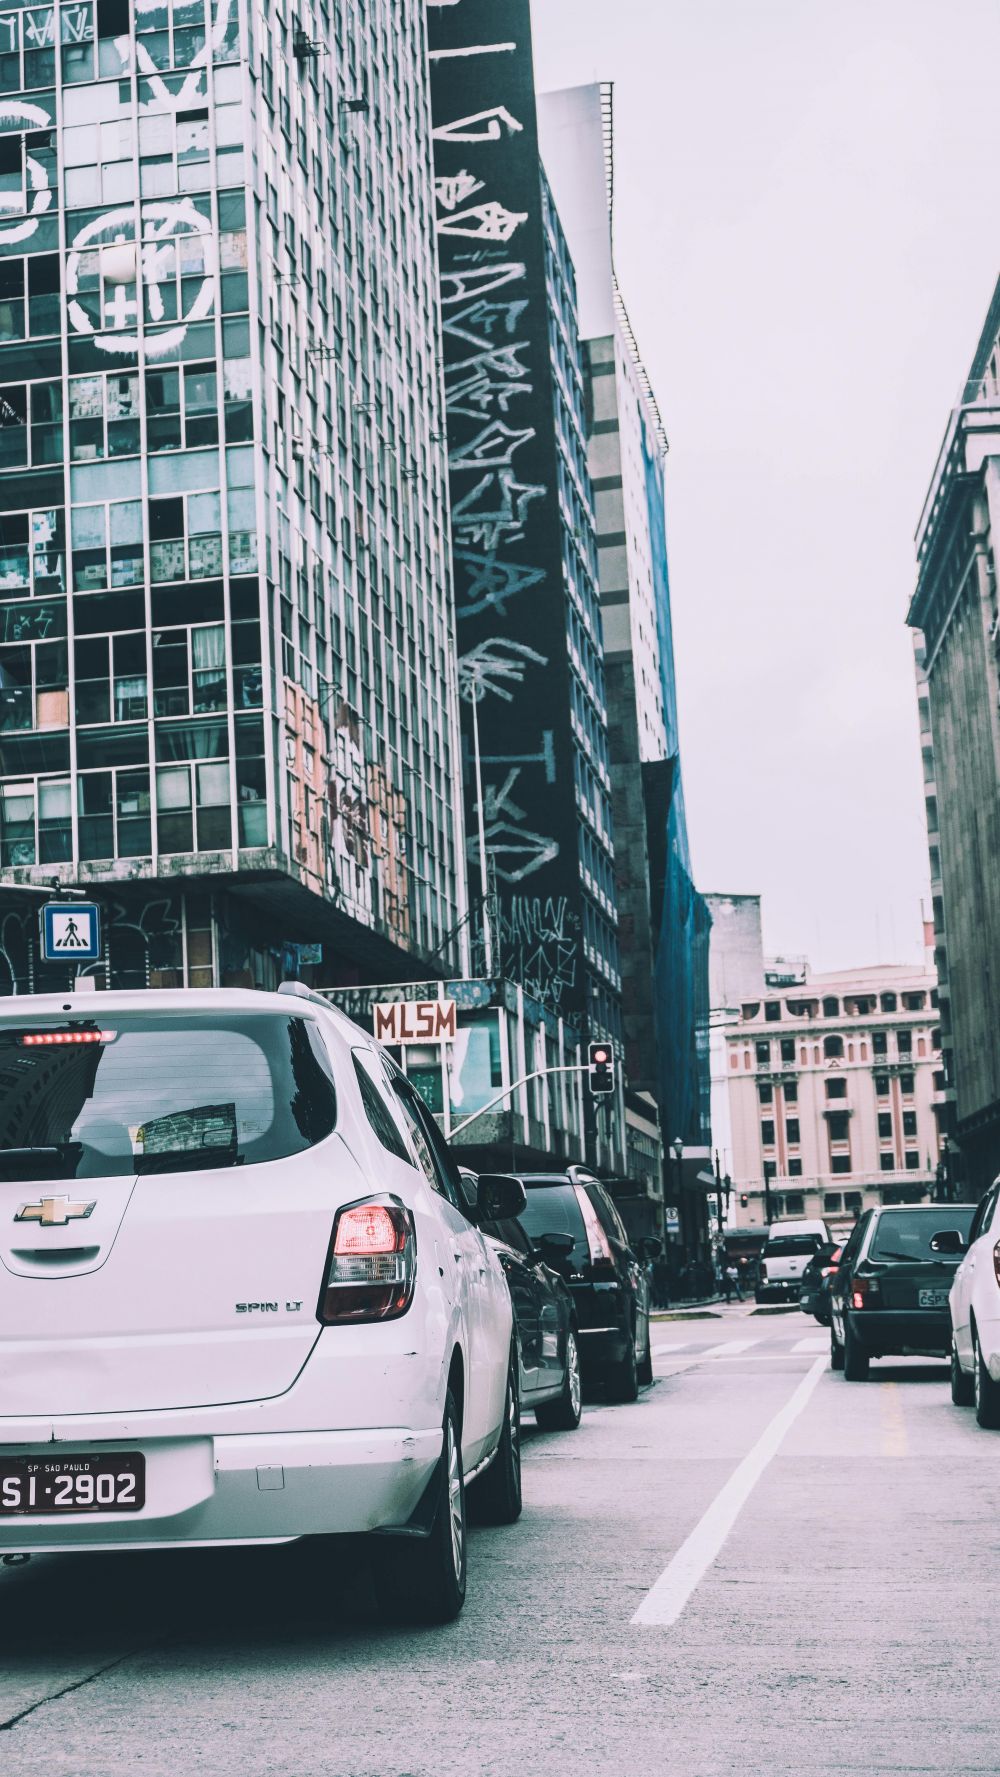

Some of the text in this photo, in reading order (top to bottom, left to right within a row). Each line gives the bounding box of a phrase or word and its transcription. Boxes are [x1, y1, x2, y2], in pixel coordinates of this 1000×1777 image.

[376, 1002, 455, 1039] MLSM
[235, 1301, 303, 1313] SPIN LT
[63, 1463, 90, 1471] PAULO
